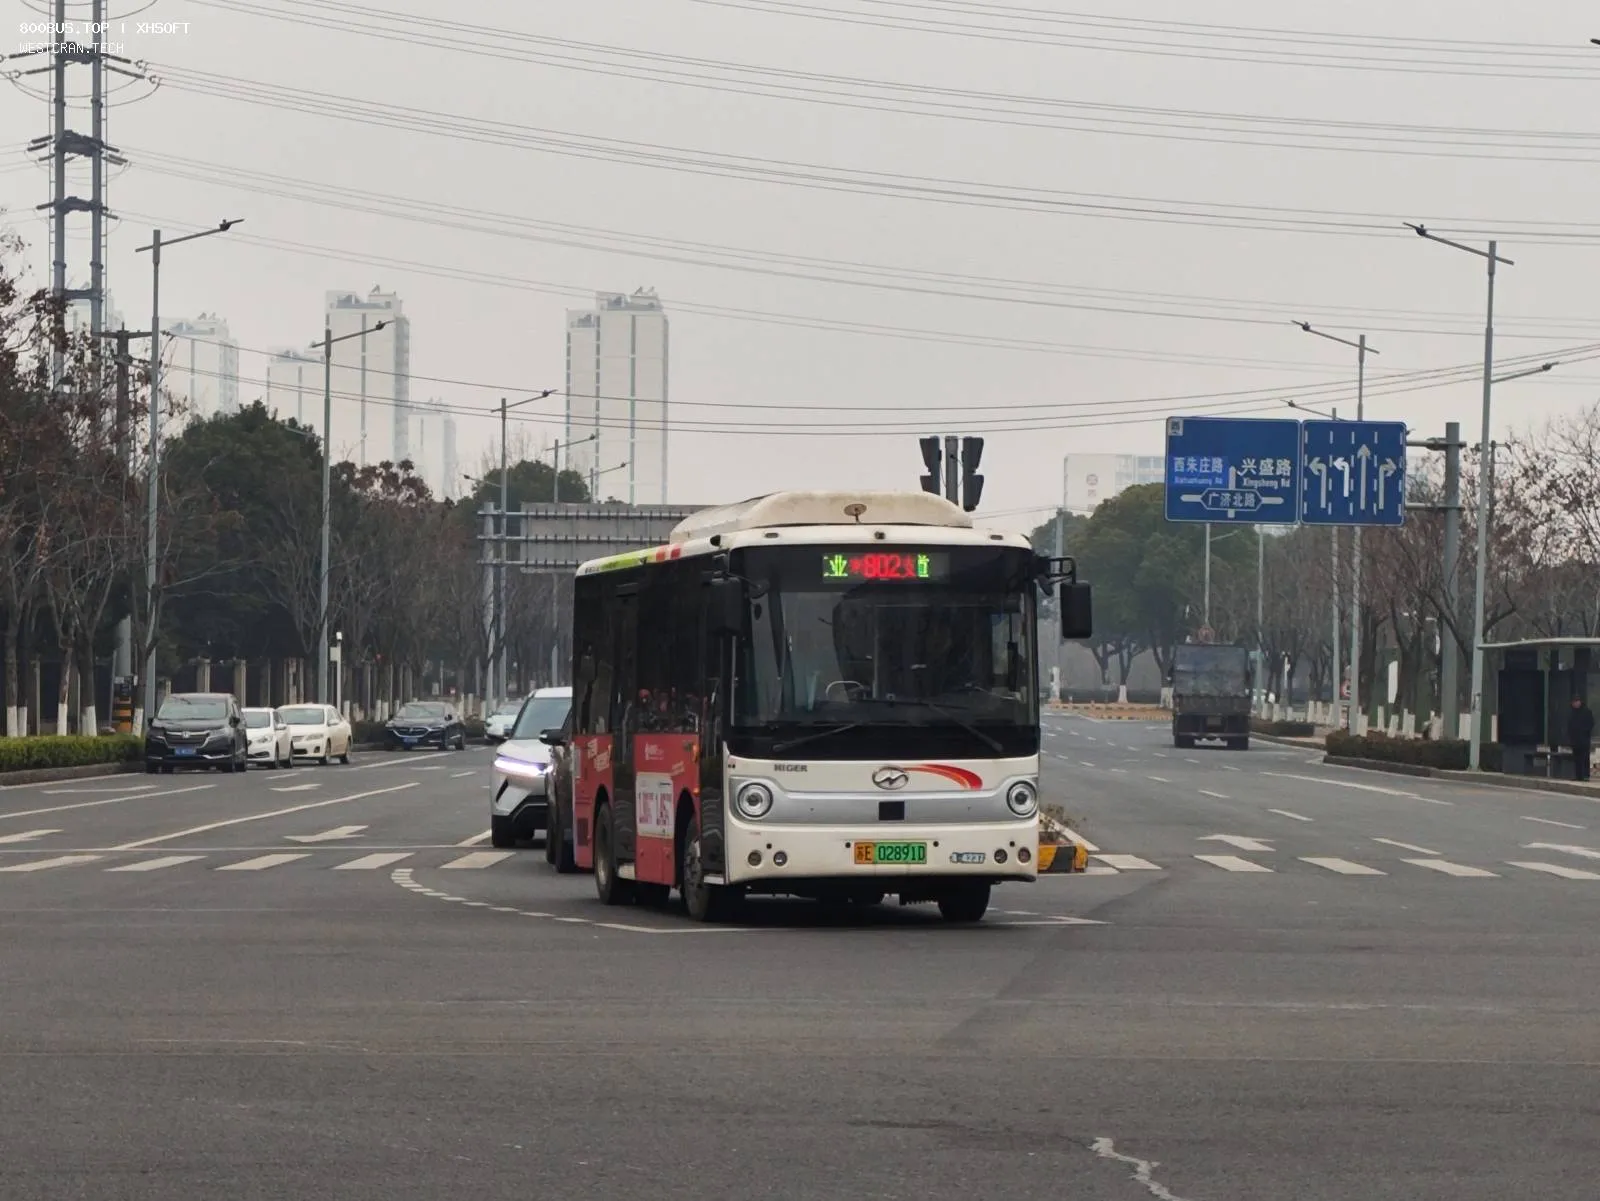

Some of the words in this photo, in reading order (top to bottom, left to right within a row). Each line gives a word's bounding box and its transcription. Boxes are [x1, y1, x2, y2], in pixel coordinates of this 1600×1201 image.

[1237, 457, 1292, 477] 兴盛路
[1208, 492, 1256, 508] 广济北路
[774, 763, 808, 773] HIGER
